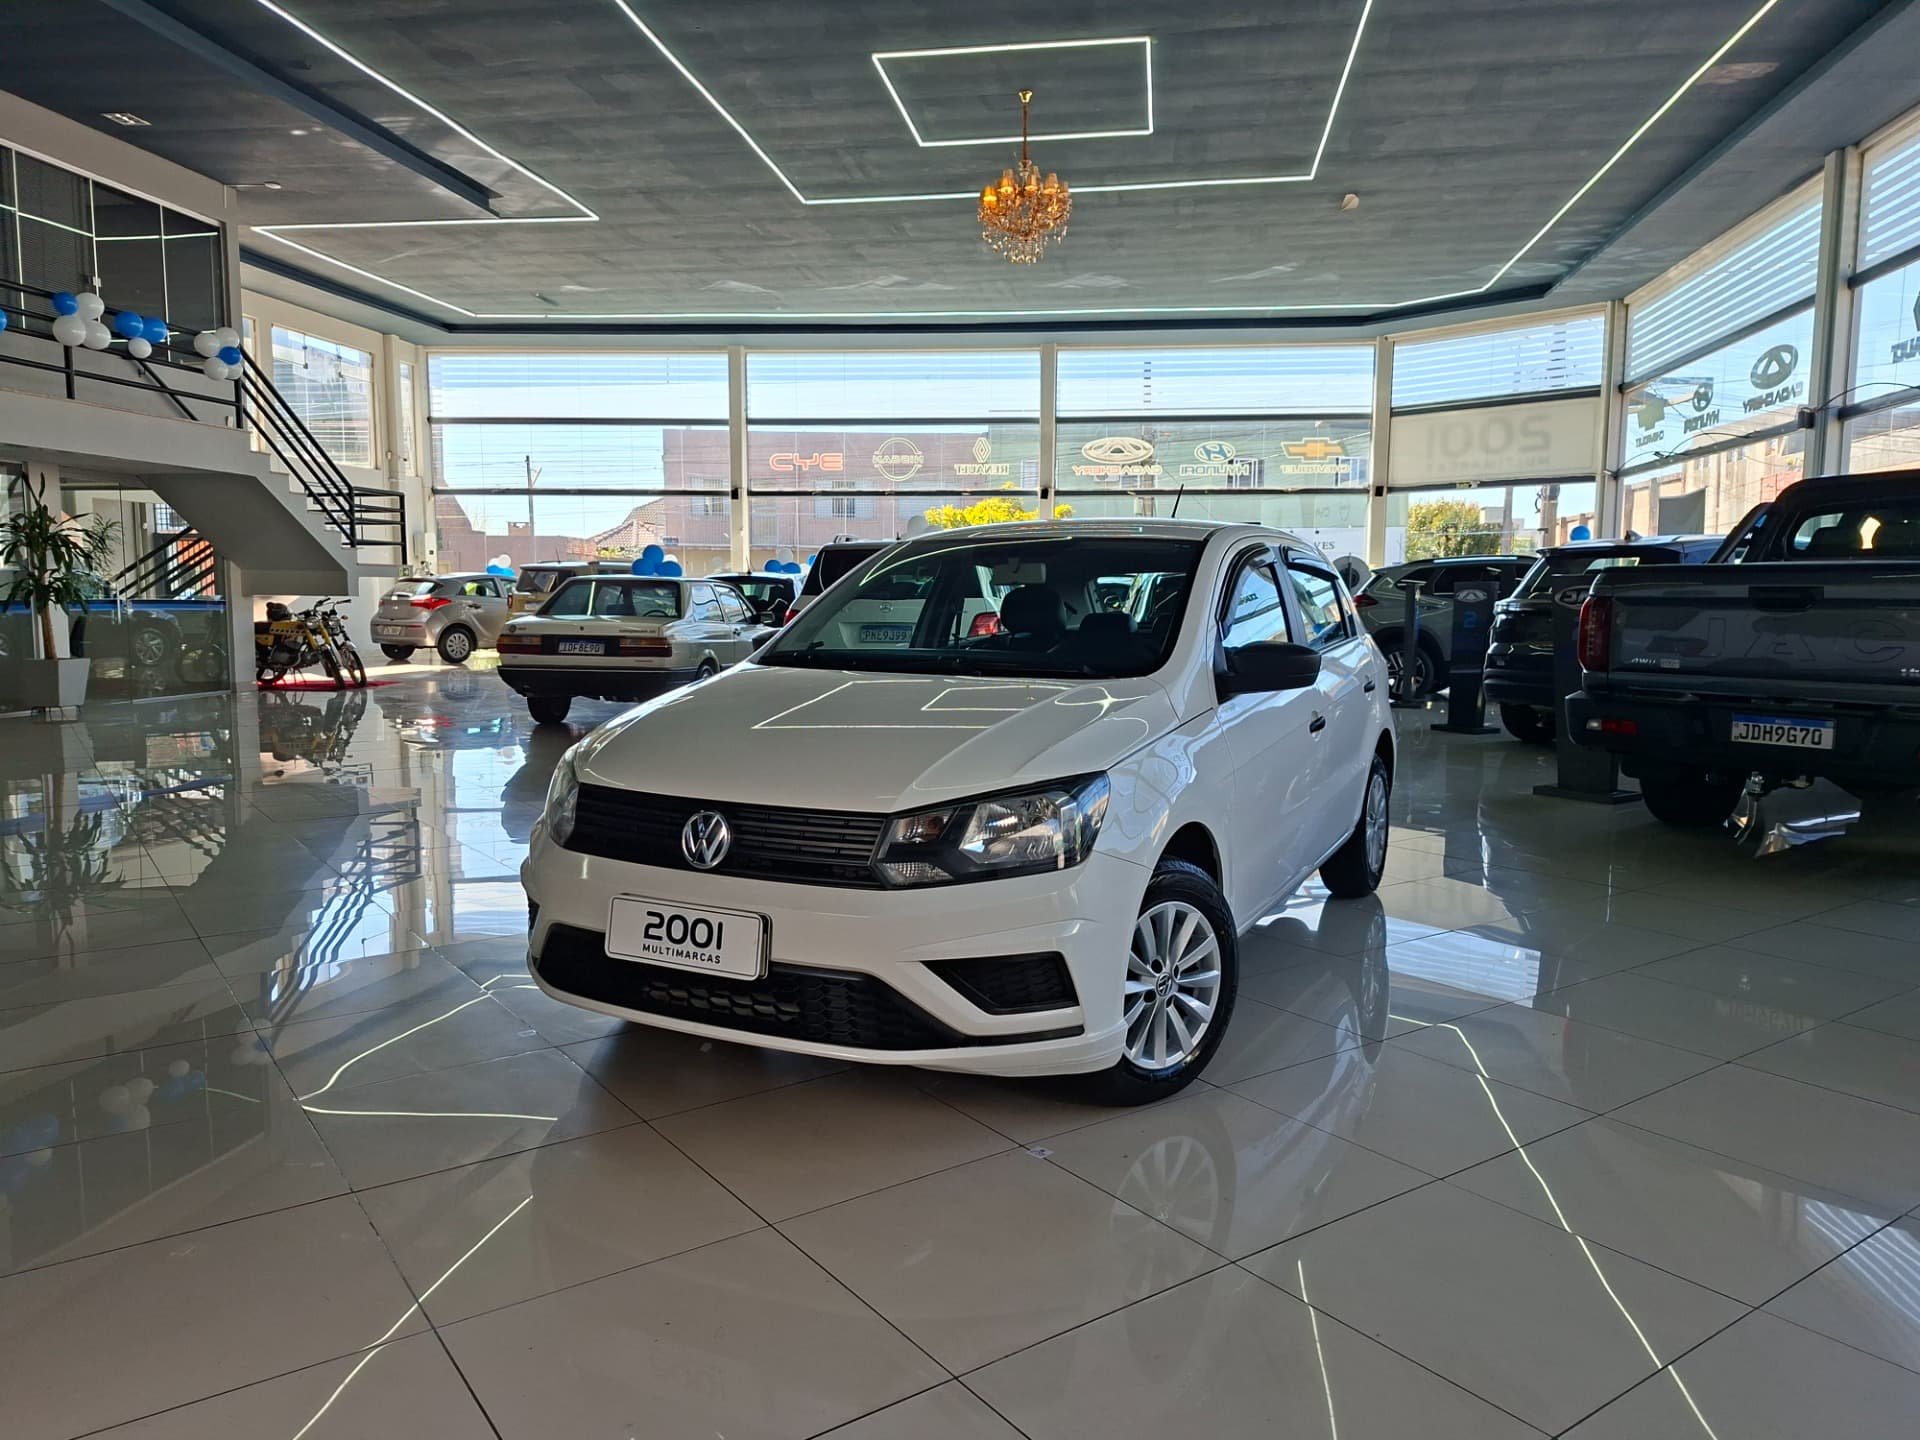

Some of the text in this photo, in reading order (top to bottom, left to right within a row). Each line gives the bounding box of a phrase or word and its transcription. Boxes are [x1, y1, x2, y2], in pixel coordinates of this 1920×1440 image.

[1739, 723, 1823, 746] JDH9G70
[643, 910, 724, 951] 2001
[642, 943, 722, 964] MULTIMARCAS
